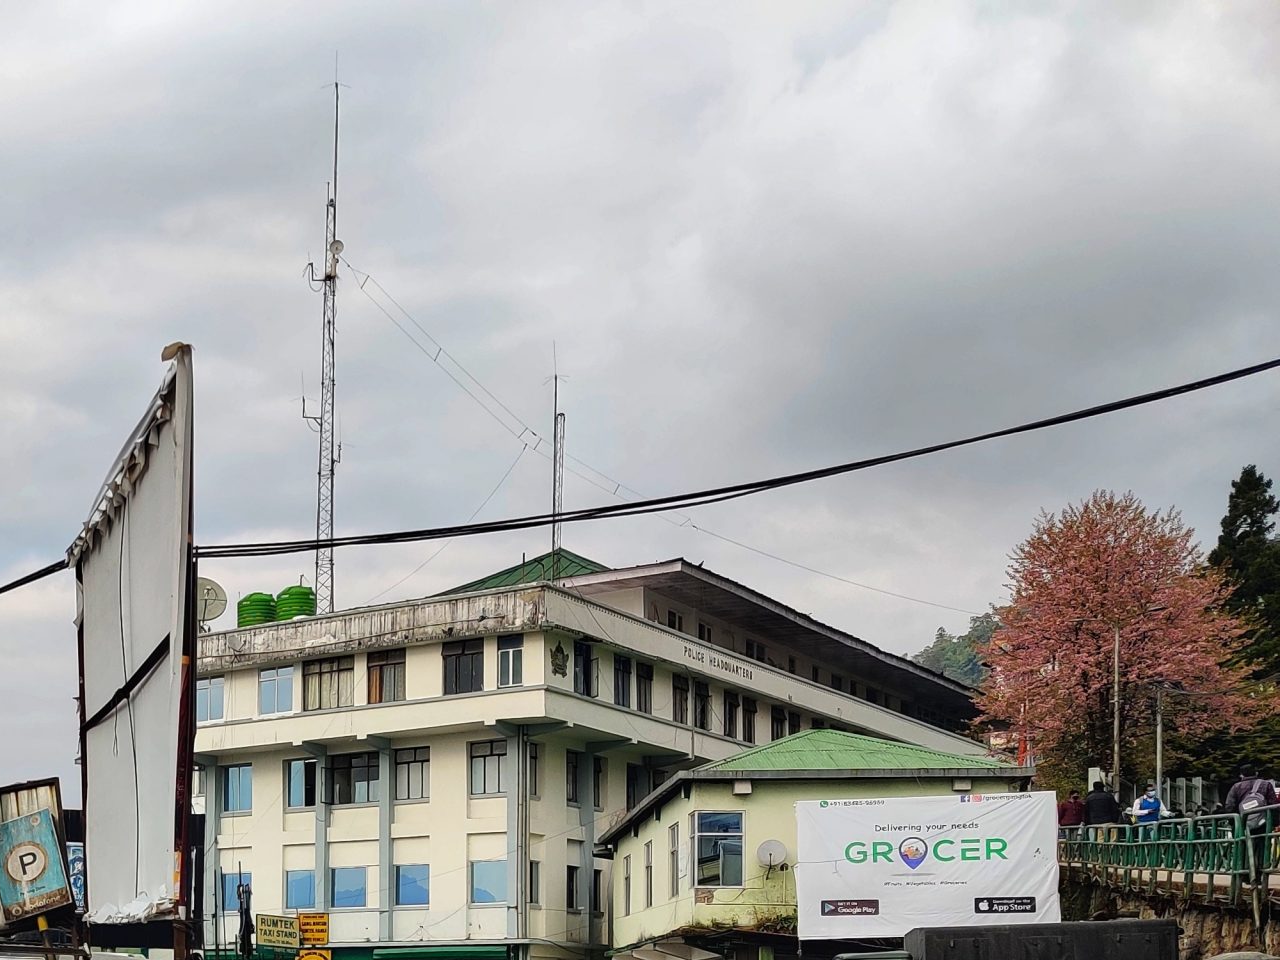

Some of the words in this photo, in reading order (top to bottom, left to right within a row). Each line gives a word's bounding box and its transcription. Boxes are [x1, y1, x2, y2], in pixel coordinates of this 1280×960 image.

[683, 646, 704, 663] POLICE
[709, 655, 753, 680] HEADQUARTERS
[874, 824, 922, 832] Delivering
[926, 823, 947, 832] your
[951, 822, 980, 830] needs
[844, 837, 1008, 867] GROCER
[19, 852, 37, 876] P
[837, 906, 862, 914] Google
[862, 906, 877, 914] Play
[992, 903, 1009, 911] App
[1009, 903, 1031, 911] Store
[261, 918, 295, 930] RUMTEK
[259, 929, 275, 937] TAXI
[275, 930, 298, 939] STAND
